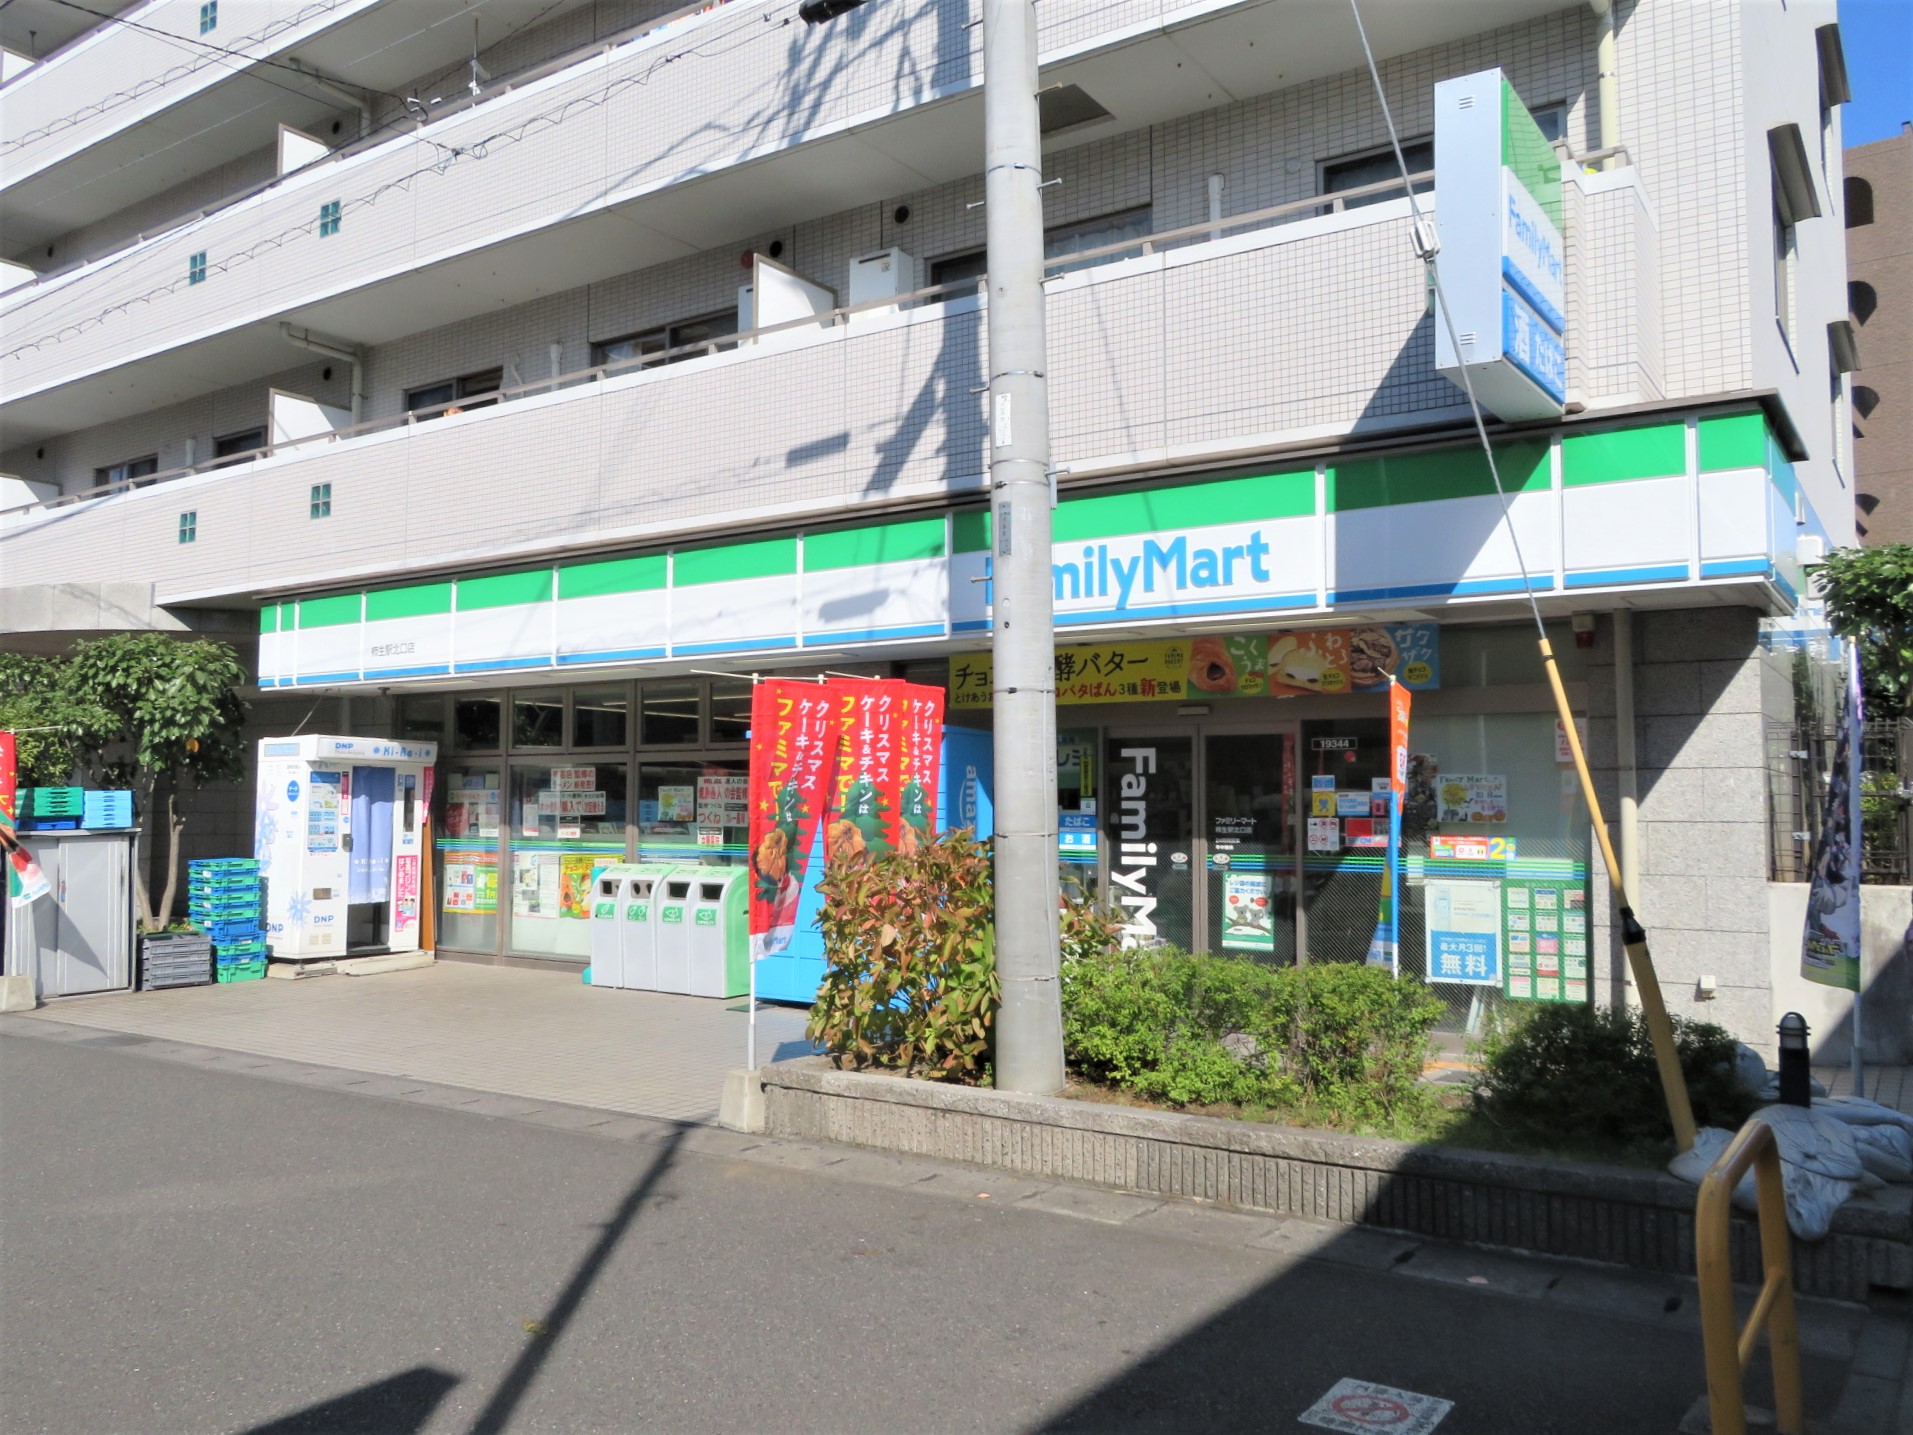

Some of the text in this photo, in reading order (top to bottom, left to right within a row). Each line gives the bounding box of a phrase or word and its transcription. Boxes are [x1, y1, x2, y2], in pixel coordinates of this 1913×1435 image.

[1508, 193, 1562, 286] FamilyMart
[1534, 329, 1563, 390] たばこ
[985, 529, 1271, 611] milyMart
[955, 663, 993, 690] チョ
[801, 700, 829, 790] クリスマス
[837, 696, 856, 812] ファミマで!
[858, 694, 875, 815] ケーキ&チキンは
[876, 694, 891, 783] クリスマス
[911, 698, 922, 815] ケーキ&チキンは
[922, 700, 935, 784] クリスマス
[1320, 739, 1350, 749] 19344
[698, 811, 721, 824] つくね
[1064, 816, 1091, 827] たばこ
[1064, 833, 1091, 844] お酒
[1215, 817, 1257, 825] ファミリーマート
[313, 914, 334, 924] DNP
[1440, 952, 1487, 977] 無料
